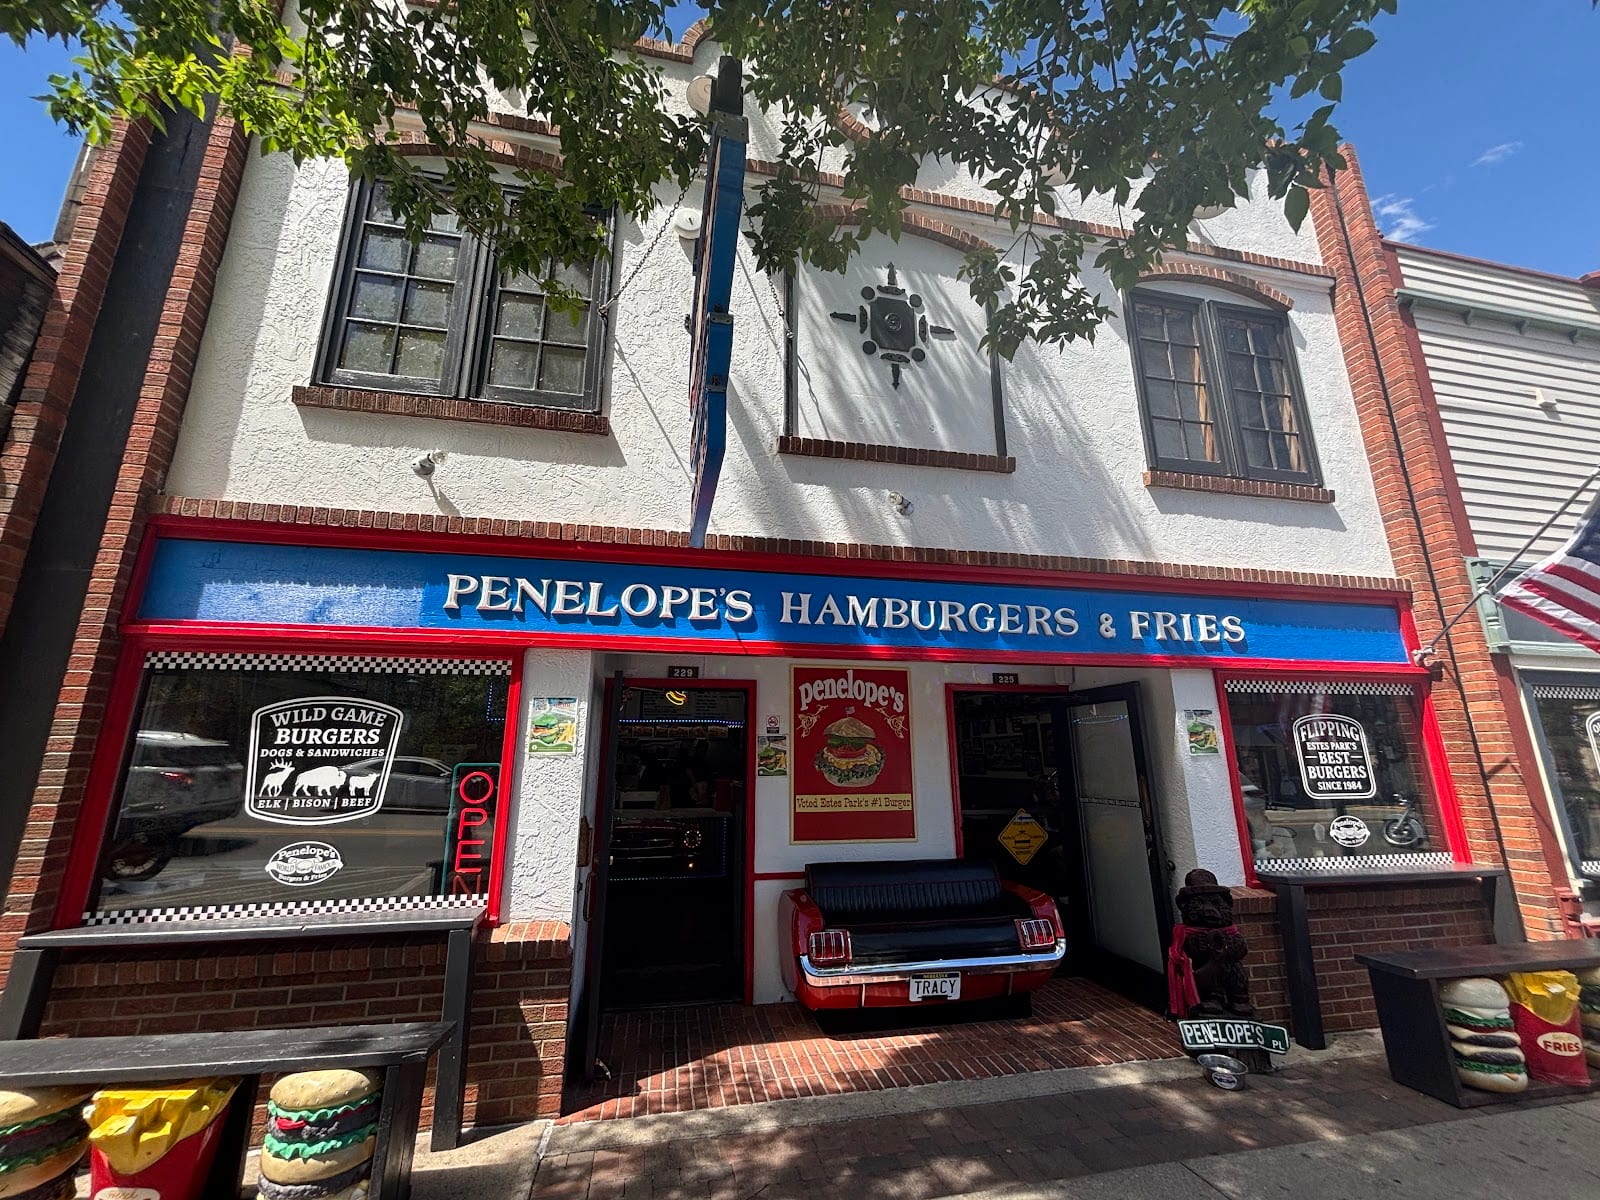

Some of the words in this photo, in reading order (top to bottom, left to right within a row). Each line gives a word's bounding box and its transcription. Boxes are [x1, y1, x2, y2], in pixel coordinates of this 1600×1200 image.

[443, 573, 752, 623] PENELOPE'S
[779, 592, 1078, 636] HAMBURGERS
[1099, 613, 1117, 640] &
[1129, 611, 1246, 643] FRIES
[673, 668, 693, 677] 229
[799, 669, 905, 713] penelope's
[270, 707, 327, 728] WILD
[330, 707, 387, 728] GAME
[274, 728, 381, 745] BURGERS
[1300, 721, 1359, 742] FLIPPING
[1306, 742, 1329, 750] ESTES
[1330, 741, 1357, 750] PARK'S
[260, 749, 293, 758] DOGS
[295, 749, 305, 757] &
[307, 748, 385, 757] SANDWICHES
[1318, 751, 1350, 764] BEST
[1307, 766, 1367, 779] BURGERS
[1317, 781, 1342, 790] SINCE
[1343, 781, 1363, 790] 1984
[257, 799, 281, 809] ELK
[292, 798, 330, 808] BISON
[341, 797, 372, 807] BEEF
[797, 798, 818, 808] Voted
[820, 797, 843, 808] Estes
[843, 797, 869, 808] Park's
[871, 797, 882, 807] #1
[884, 797, 911, 810] Burger
[453, 771, 494, 899] OPEN
[277, 845, 336, 860] Penelope's
[914, 980, 956, 995] TRACY
[1183, 1023, 1265, 1045] PENELOPE'S
[1272, 1040, 1285, 1050] PL
[1542, 1040, 1580, 1052] FRIES
